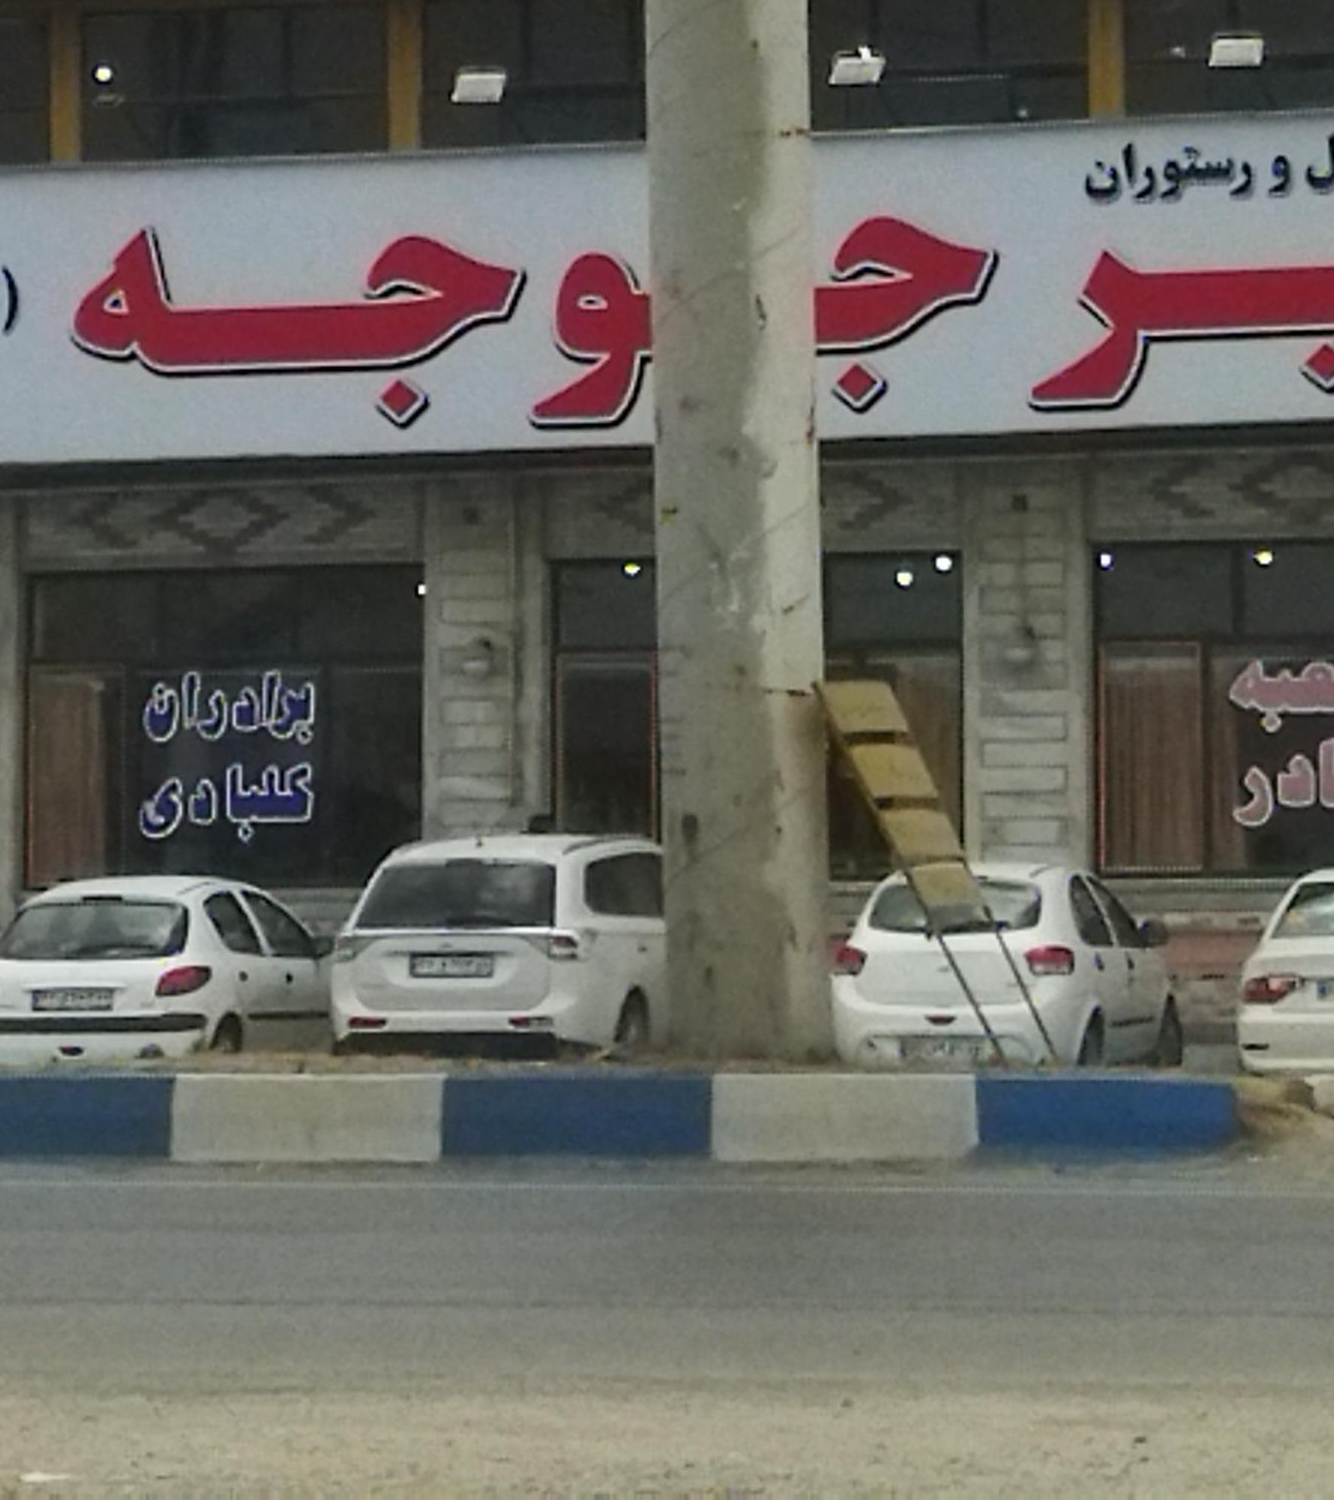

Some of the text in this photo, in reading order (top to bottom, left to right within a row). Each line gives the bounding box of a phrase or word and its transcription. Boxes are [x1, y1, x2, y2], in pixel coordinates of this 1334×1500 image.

[1084, 141, 1255, 202] رستوران
[1267, 153, 1292, 198] و
[70, 214, 999, 428] جوجه
[143, 670, 316, 745] برادران
[139, 762, 315, 844] کلبادی
